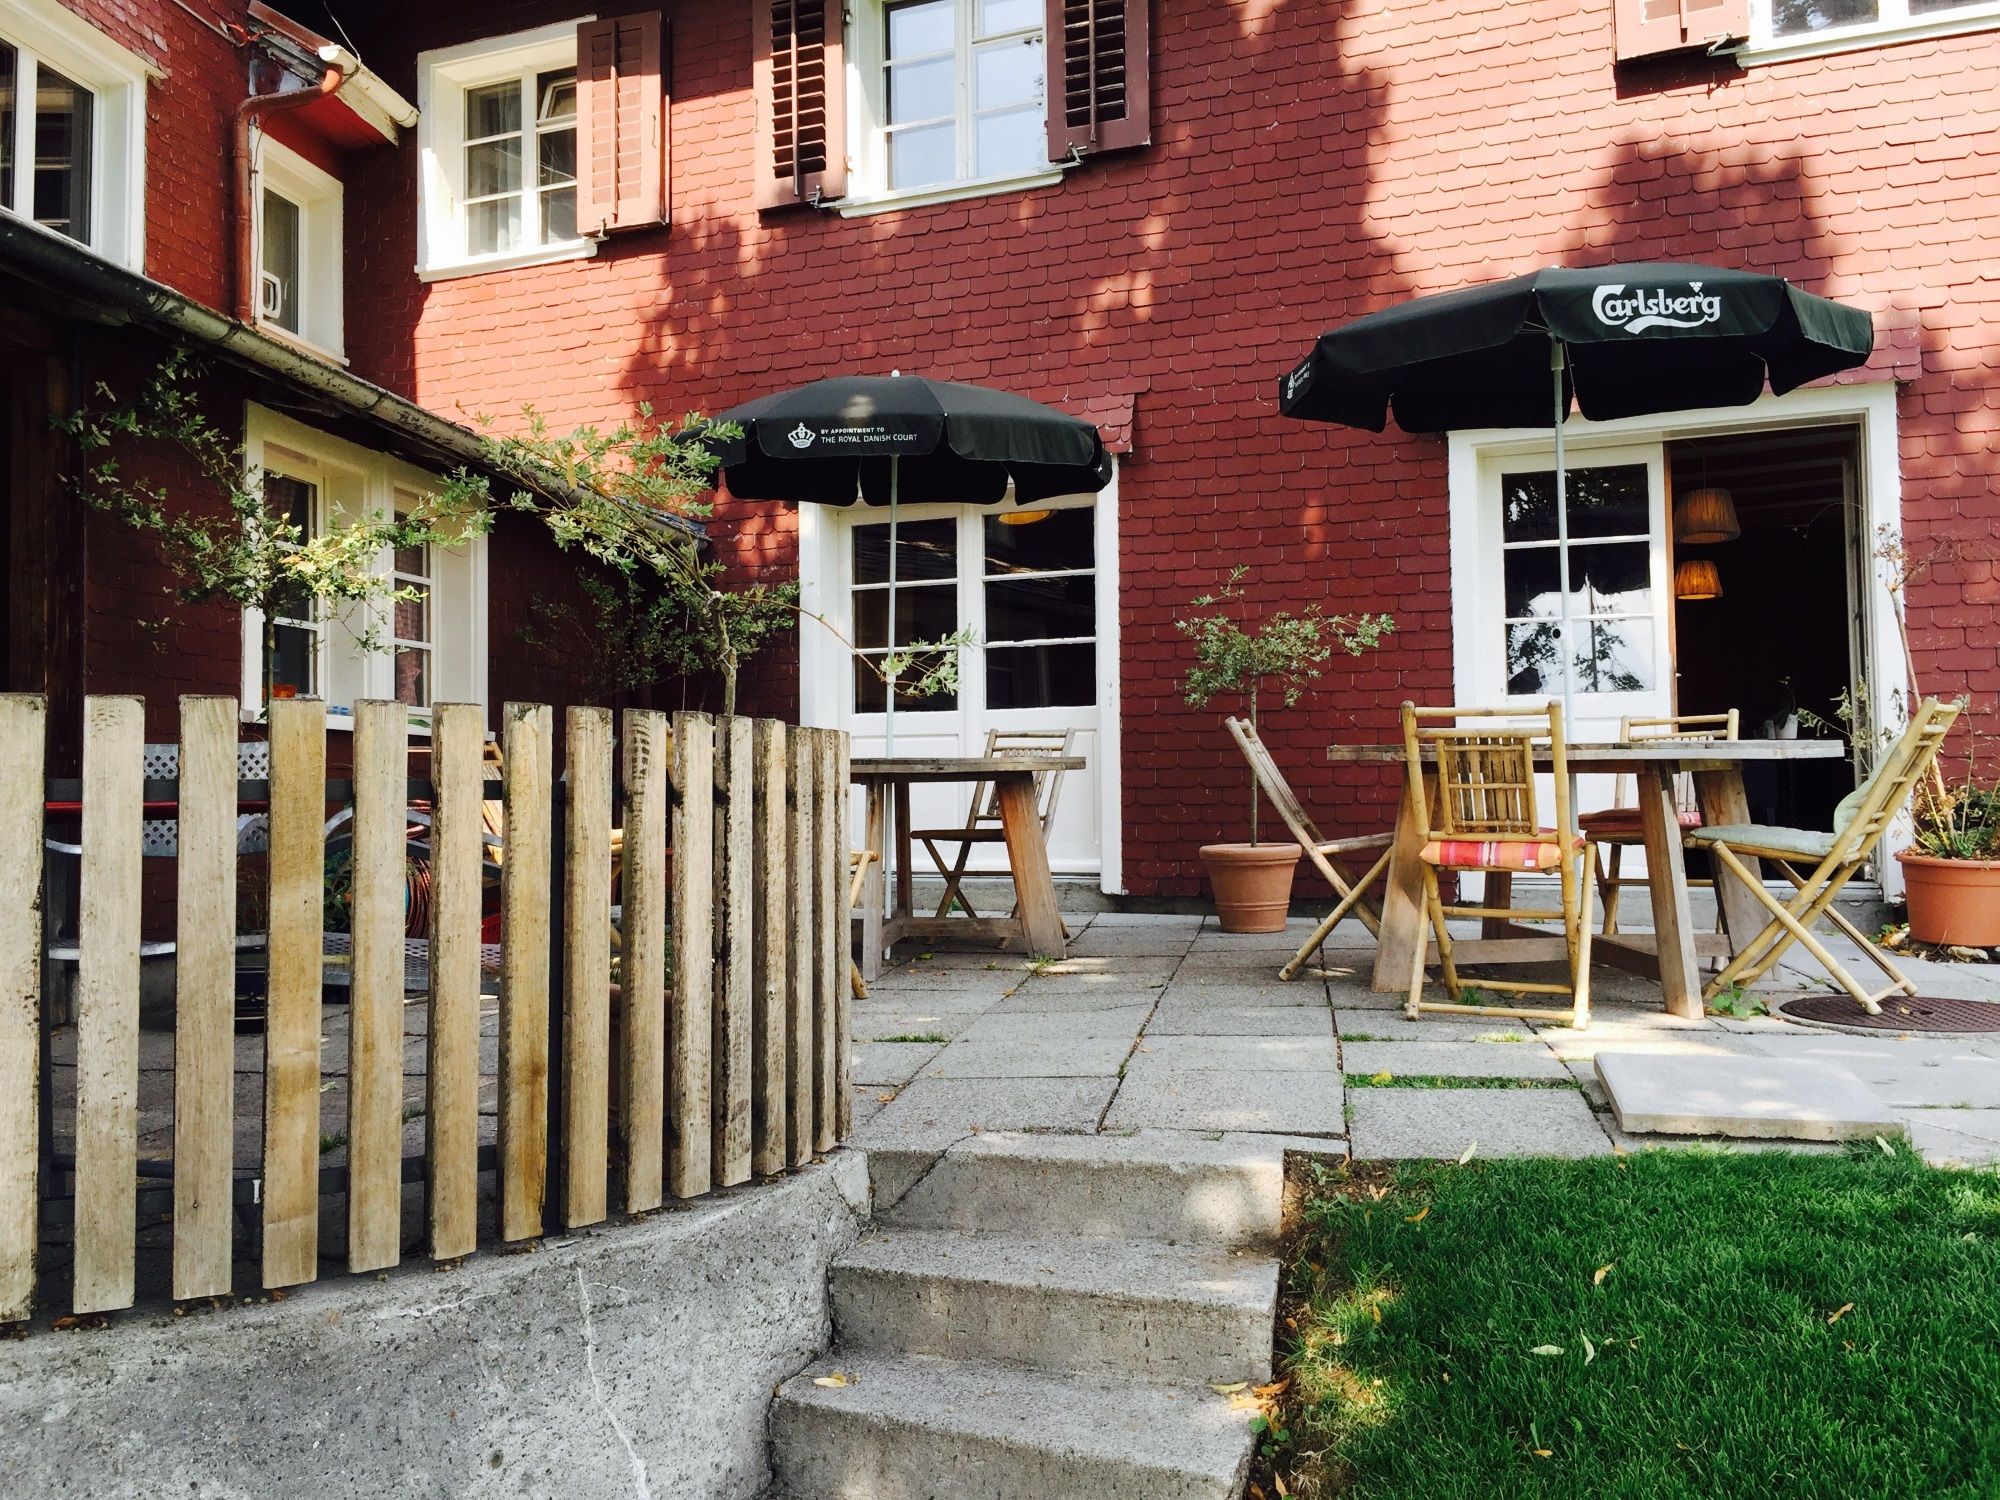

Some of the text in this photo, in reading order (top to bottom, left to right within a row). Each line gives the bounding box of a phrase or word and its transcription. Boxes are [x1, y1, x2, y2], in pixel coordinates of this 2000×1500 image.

[1592, 282, 1721, 334] Carlsberg
[821, 433, 918, 444] THE ROYAL DANISH COURT
